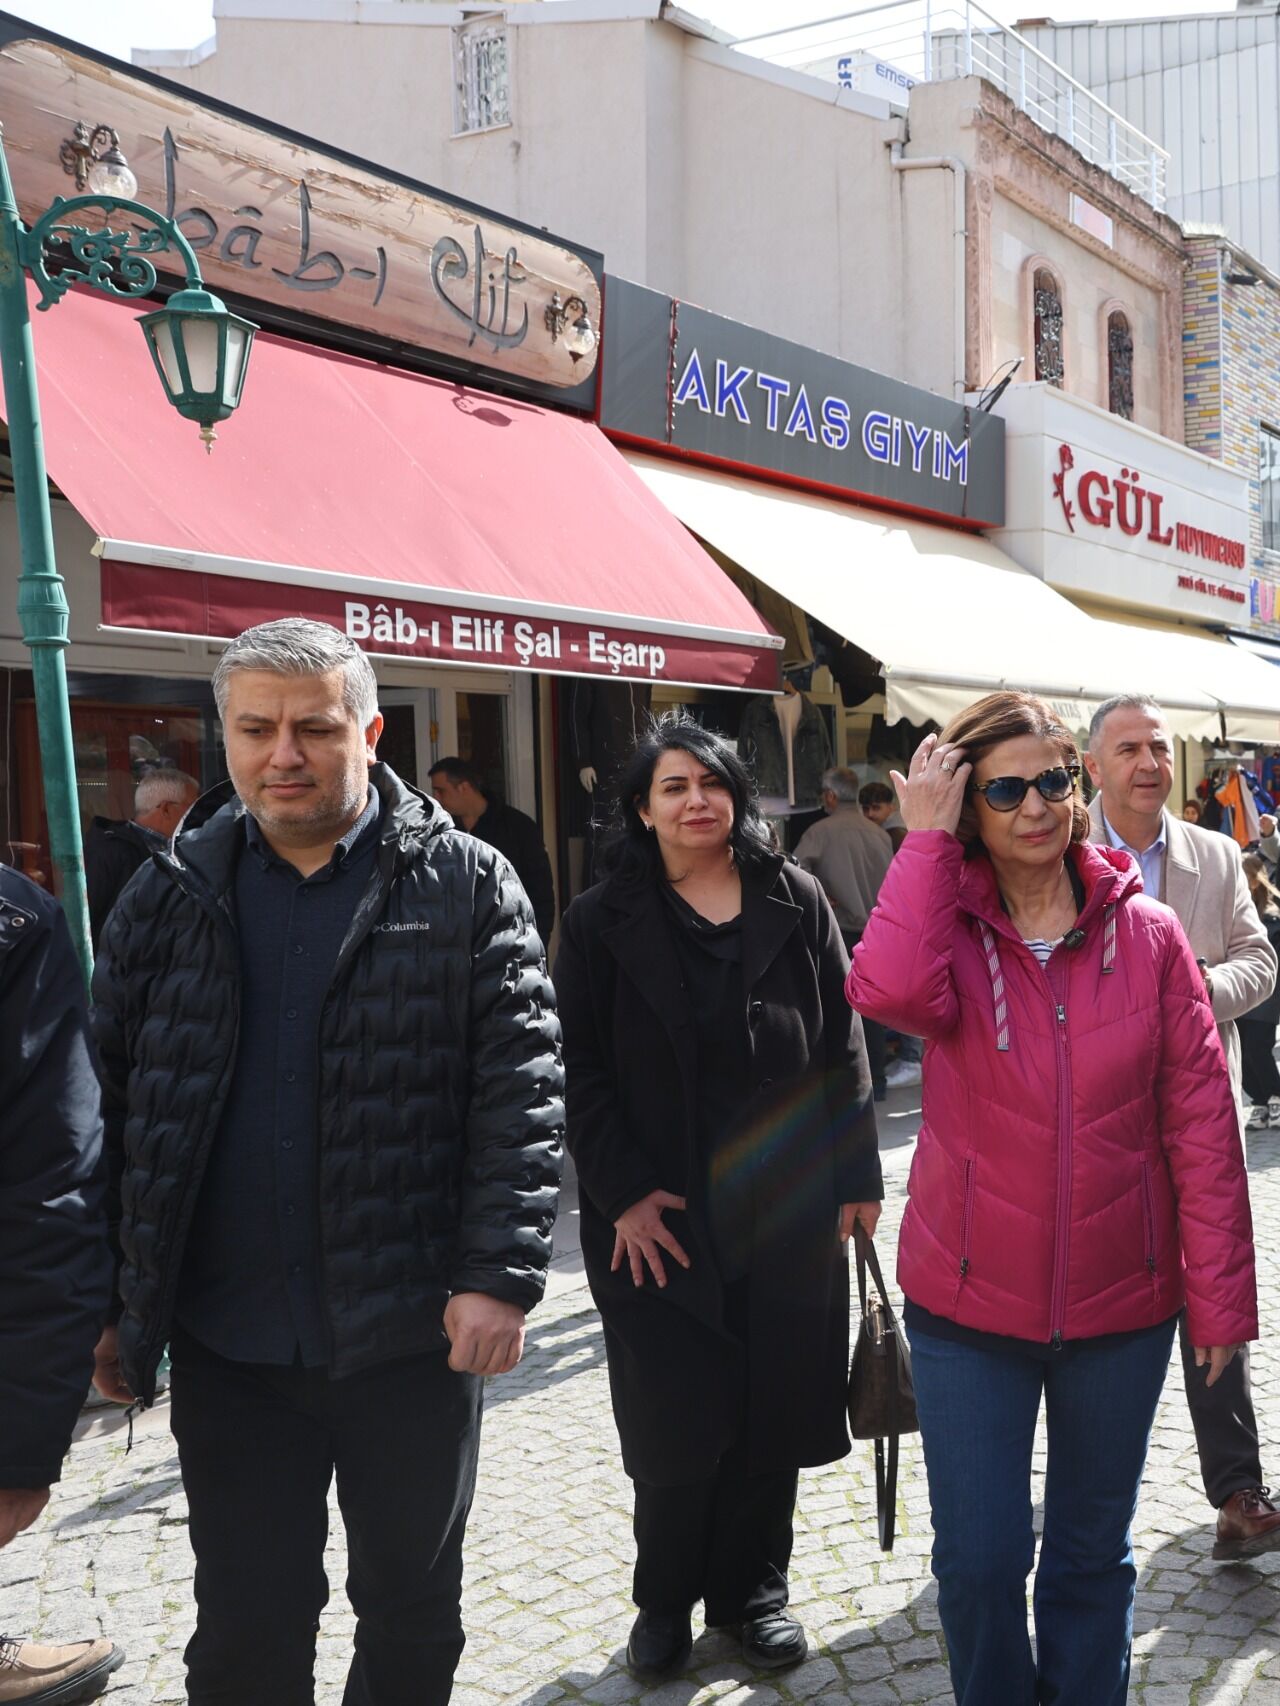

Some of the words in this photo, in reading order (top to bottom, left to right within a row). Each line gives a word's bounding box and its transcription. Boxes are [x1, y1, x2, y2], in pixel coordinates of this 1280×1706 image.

[1077, 467, 1174, 546] GÜL
[1175, 521, 1246, 571] KUYUMCUSU
[345, 601, 440, 648] Bâb-ı
[452, 615, 506, 653] Elif
[514, 620, 561, 665] Şal
[589, 631, 666, 677] Eşarp
[380, 920, 431, 933] Columbia
